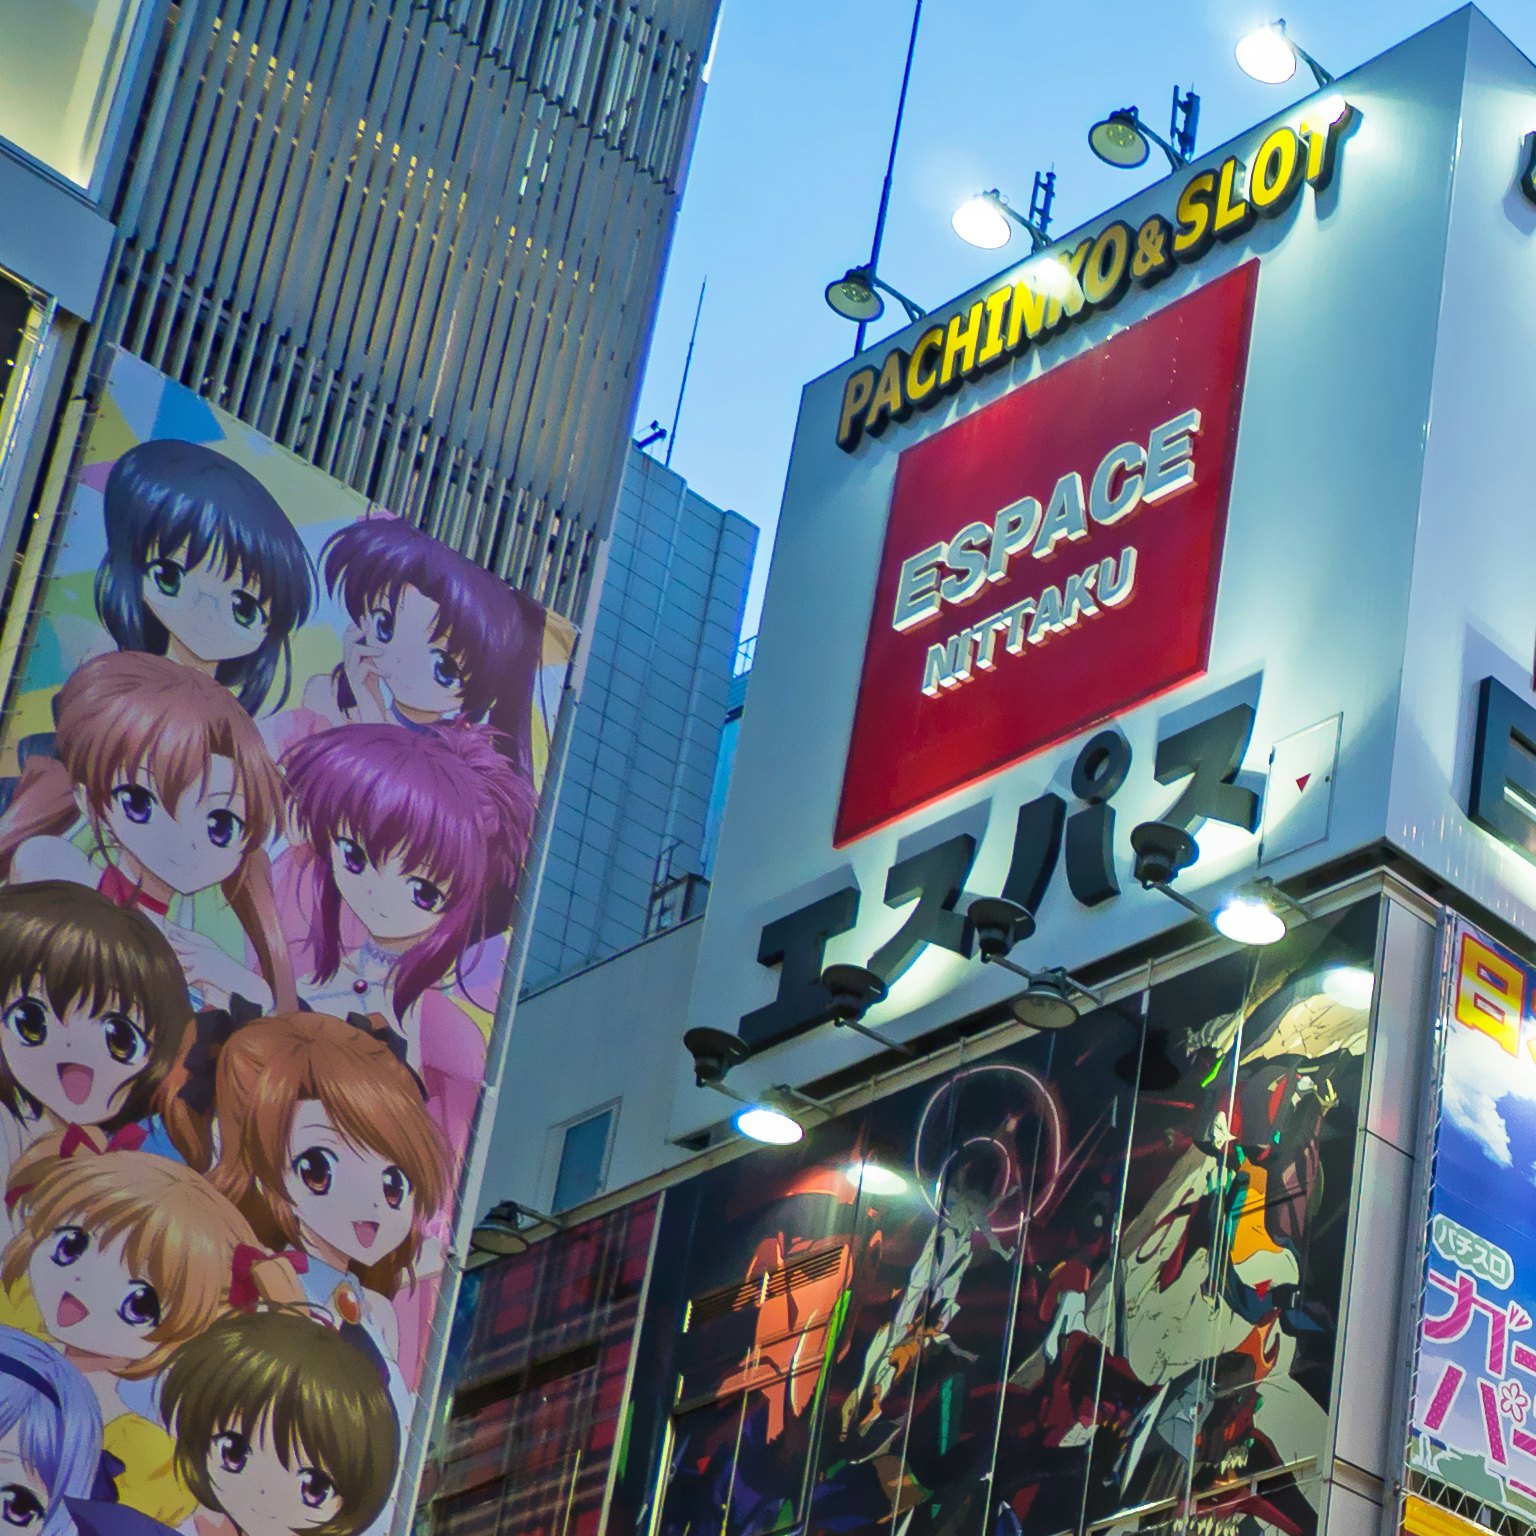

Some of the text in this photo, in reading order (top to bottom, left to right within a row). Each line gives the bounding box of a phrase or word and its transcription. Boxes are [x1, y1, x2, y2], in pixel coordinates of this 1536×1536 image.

[893, 408, 1200, 632] ESPACE
[921, 546, 1137, 697] NITTAKU
[738, 702, 1258, 1048] エスパス
[1437, 1221, 1508, 1286] パチスロ
